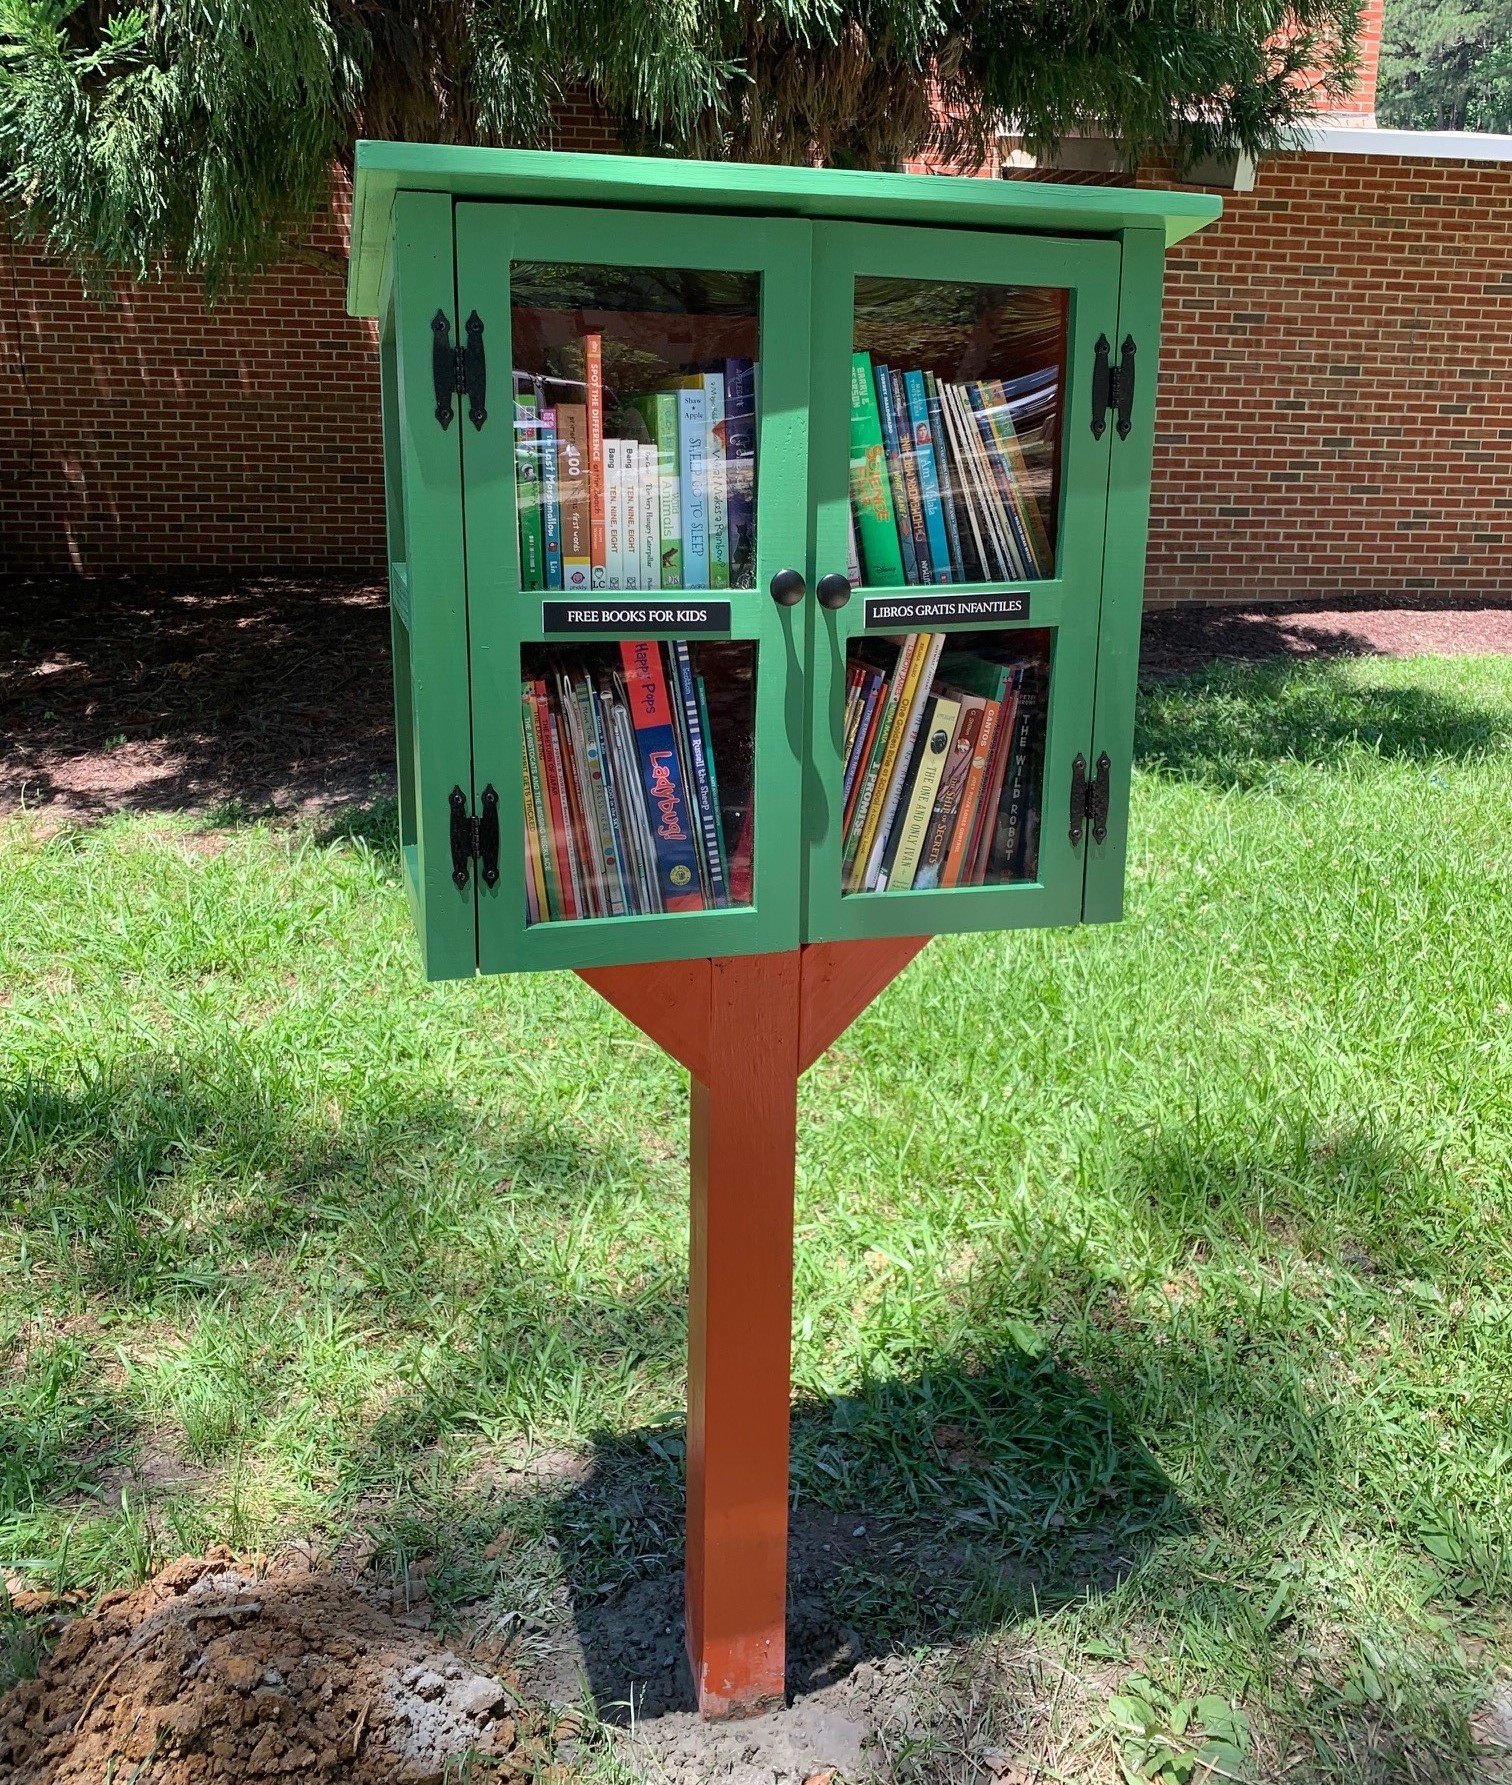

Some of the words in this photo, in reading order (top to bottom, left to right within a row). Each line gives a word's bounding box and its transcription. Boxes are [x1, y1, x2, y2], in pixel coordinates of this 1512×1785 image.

[591, 364, 599, 388] SPOT
[736, 368, 744, 407] APPLEGATE
[857, 366, 868, 397] BARRY
[879, 372, 888, 395] TORREY
[861, 397, 870, 406] &
[684, 412, 702, 420] Apple
[882, 395, 893, 434] MALDONADO
[592, 410, 600, 462] DIFFERENCE
[545, 449, 555, 473] Last
[568, 452, 580, 476] 100
[608, 448, 616, 468] Bang
[899, 432, 915, 476] MACHINE
[893, 469, 903, 491] WHAT
[919, 458, 932, 478] Am
[692, 479, 702, 498] GO
[865, 443, 890, 522] SCIENCE
[546, 474, 556, 536] Marshmallow
[593, 488, 602, 514] beach
[662, 480, 674, 536] Animals
[672, 492, 680, 514] Wild
[690, 500, 702, 518] TO
[714, 482, 723, 513] Makes
[896, 494, 907, 518] LANE?
[906, 477, 923, 529] HOMEWORK
[923, 480, 939, 515] Malala
[572, 512, 580, 530] first
[610, 506, 618, 528] NINE,
[572, 532, 580, 552] words
[691, 522, 704, 557] SLEEP
[714, 524, 726, 568] Rainbow?
[646, 536, 654, 568] Caterpillar
[550, 561, 558, 574] Lin
[568, 610, 600, 622] FREE
[601, 610, 646, 622] BOOKS
[648, 610, 674, 622] FOR
[676, 610, 708, 622] KIDS
[872, 606, 914, 618] LIBROS
[915, 603, 956, 616] GRATIS
[958, 600, 1022, 614] INFANTILES
[631, 642, 653, 681] Happy
[900, 643, 913, 672] LEBRON
[681, 667, 692, 694] Scotton
[893, 671, 906, 696] JAMES
[638, 681, 660, 715] Pops
[897, 697, 910, 717] One
[523, 716, 532, 731] THE
[532, 710, 540, 723] THE
[540, 718, 549, 732] THE
[864, 708, 872, 721] THE
[885, 703, 896, 723] NINA
[534, 724, 543, 742] LION
[879, 724, 890, 744] MATA
[889, 718, 904, 749] Golden
[979, 708, 995, 747] GANTOS
[1020, 714, 1031, 747] THE
[525, 731, 537, 774] ARISTOCATS
[536, 742, 546, 761] KING
[543, 733, 552, 761] RETURN
[692, 738, 704, 767] Russell
[883, 748, 895, 768] Rule
[547, 762, 555, 772] OF
[696, 767, 707, 785] the
[849, 759, 857, 776] NEW
[871, 760, 881, 770] I
[881, 768, 889, 777] at
[922, 764, 937, 784] THE
[1013, 754, 1026, 799] WILD
[522, 774, 531, 796] GETS
[531, 774, 539, 790] AND
[549, 772, 558, 796] JAFAR
[606, 784, 614, 799] ZOO
[872, 776, 887, 806] School
[917, 783, 932, 802] ONE
[533, 790, 541, 804] THE
[641, 748, 690, 844] Ladybug!
[697, 784, 710, 811] Sheep
[851, 772, 877, 837] PROMISE
[942, 790, 955, 815] SHIP
[525, 798, 535, 832] TRICKED
[535, 805, 545, 833] MISSING
[594, 784, 604, 809] PRESS
[599, 812, 608, 833] HERE
[912, 802, 927, 822] AND
[960, 808, 969, 826] LOSES
[906, 822, 921, 845] ONLY
[927, 822, 946, 864] SECRETS
[954, 826, 964, 852] CONTROL
[1006, 804, 1018, 861] ROBOT
[539, 834, 551, 871] NECKLACE
[900, 845, 915, 868] IVAN
